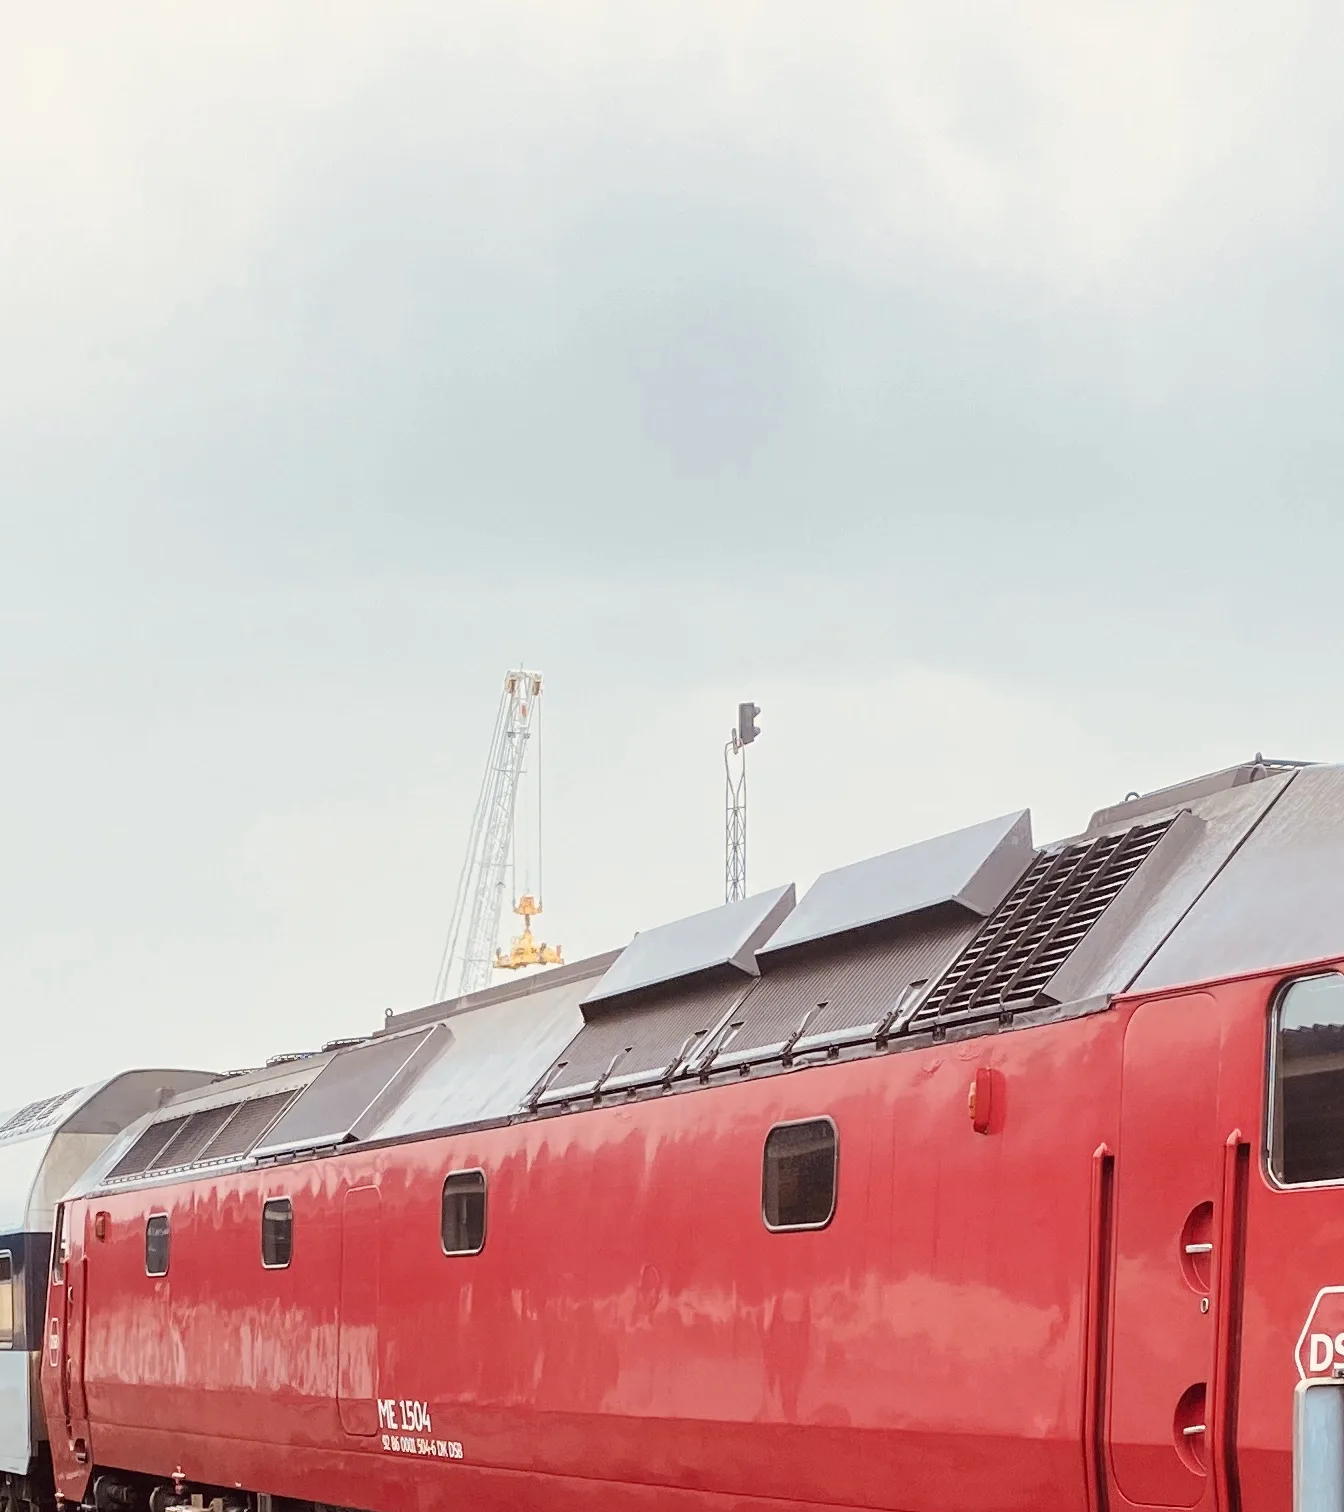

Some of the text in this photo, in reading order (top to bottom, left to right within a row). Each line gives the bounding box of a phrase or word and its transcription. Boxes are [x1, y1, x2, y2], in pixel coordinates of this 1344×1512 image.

[377, 1398, 431, 1432] ME 1504
[436, 1440, 448, 1457] DK
[448, 1441, 463, 1458] DSB
